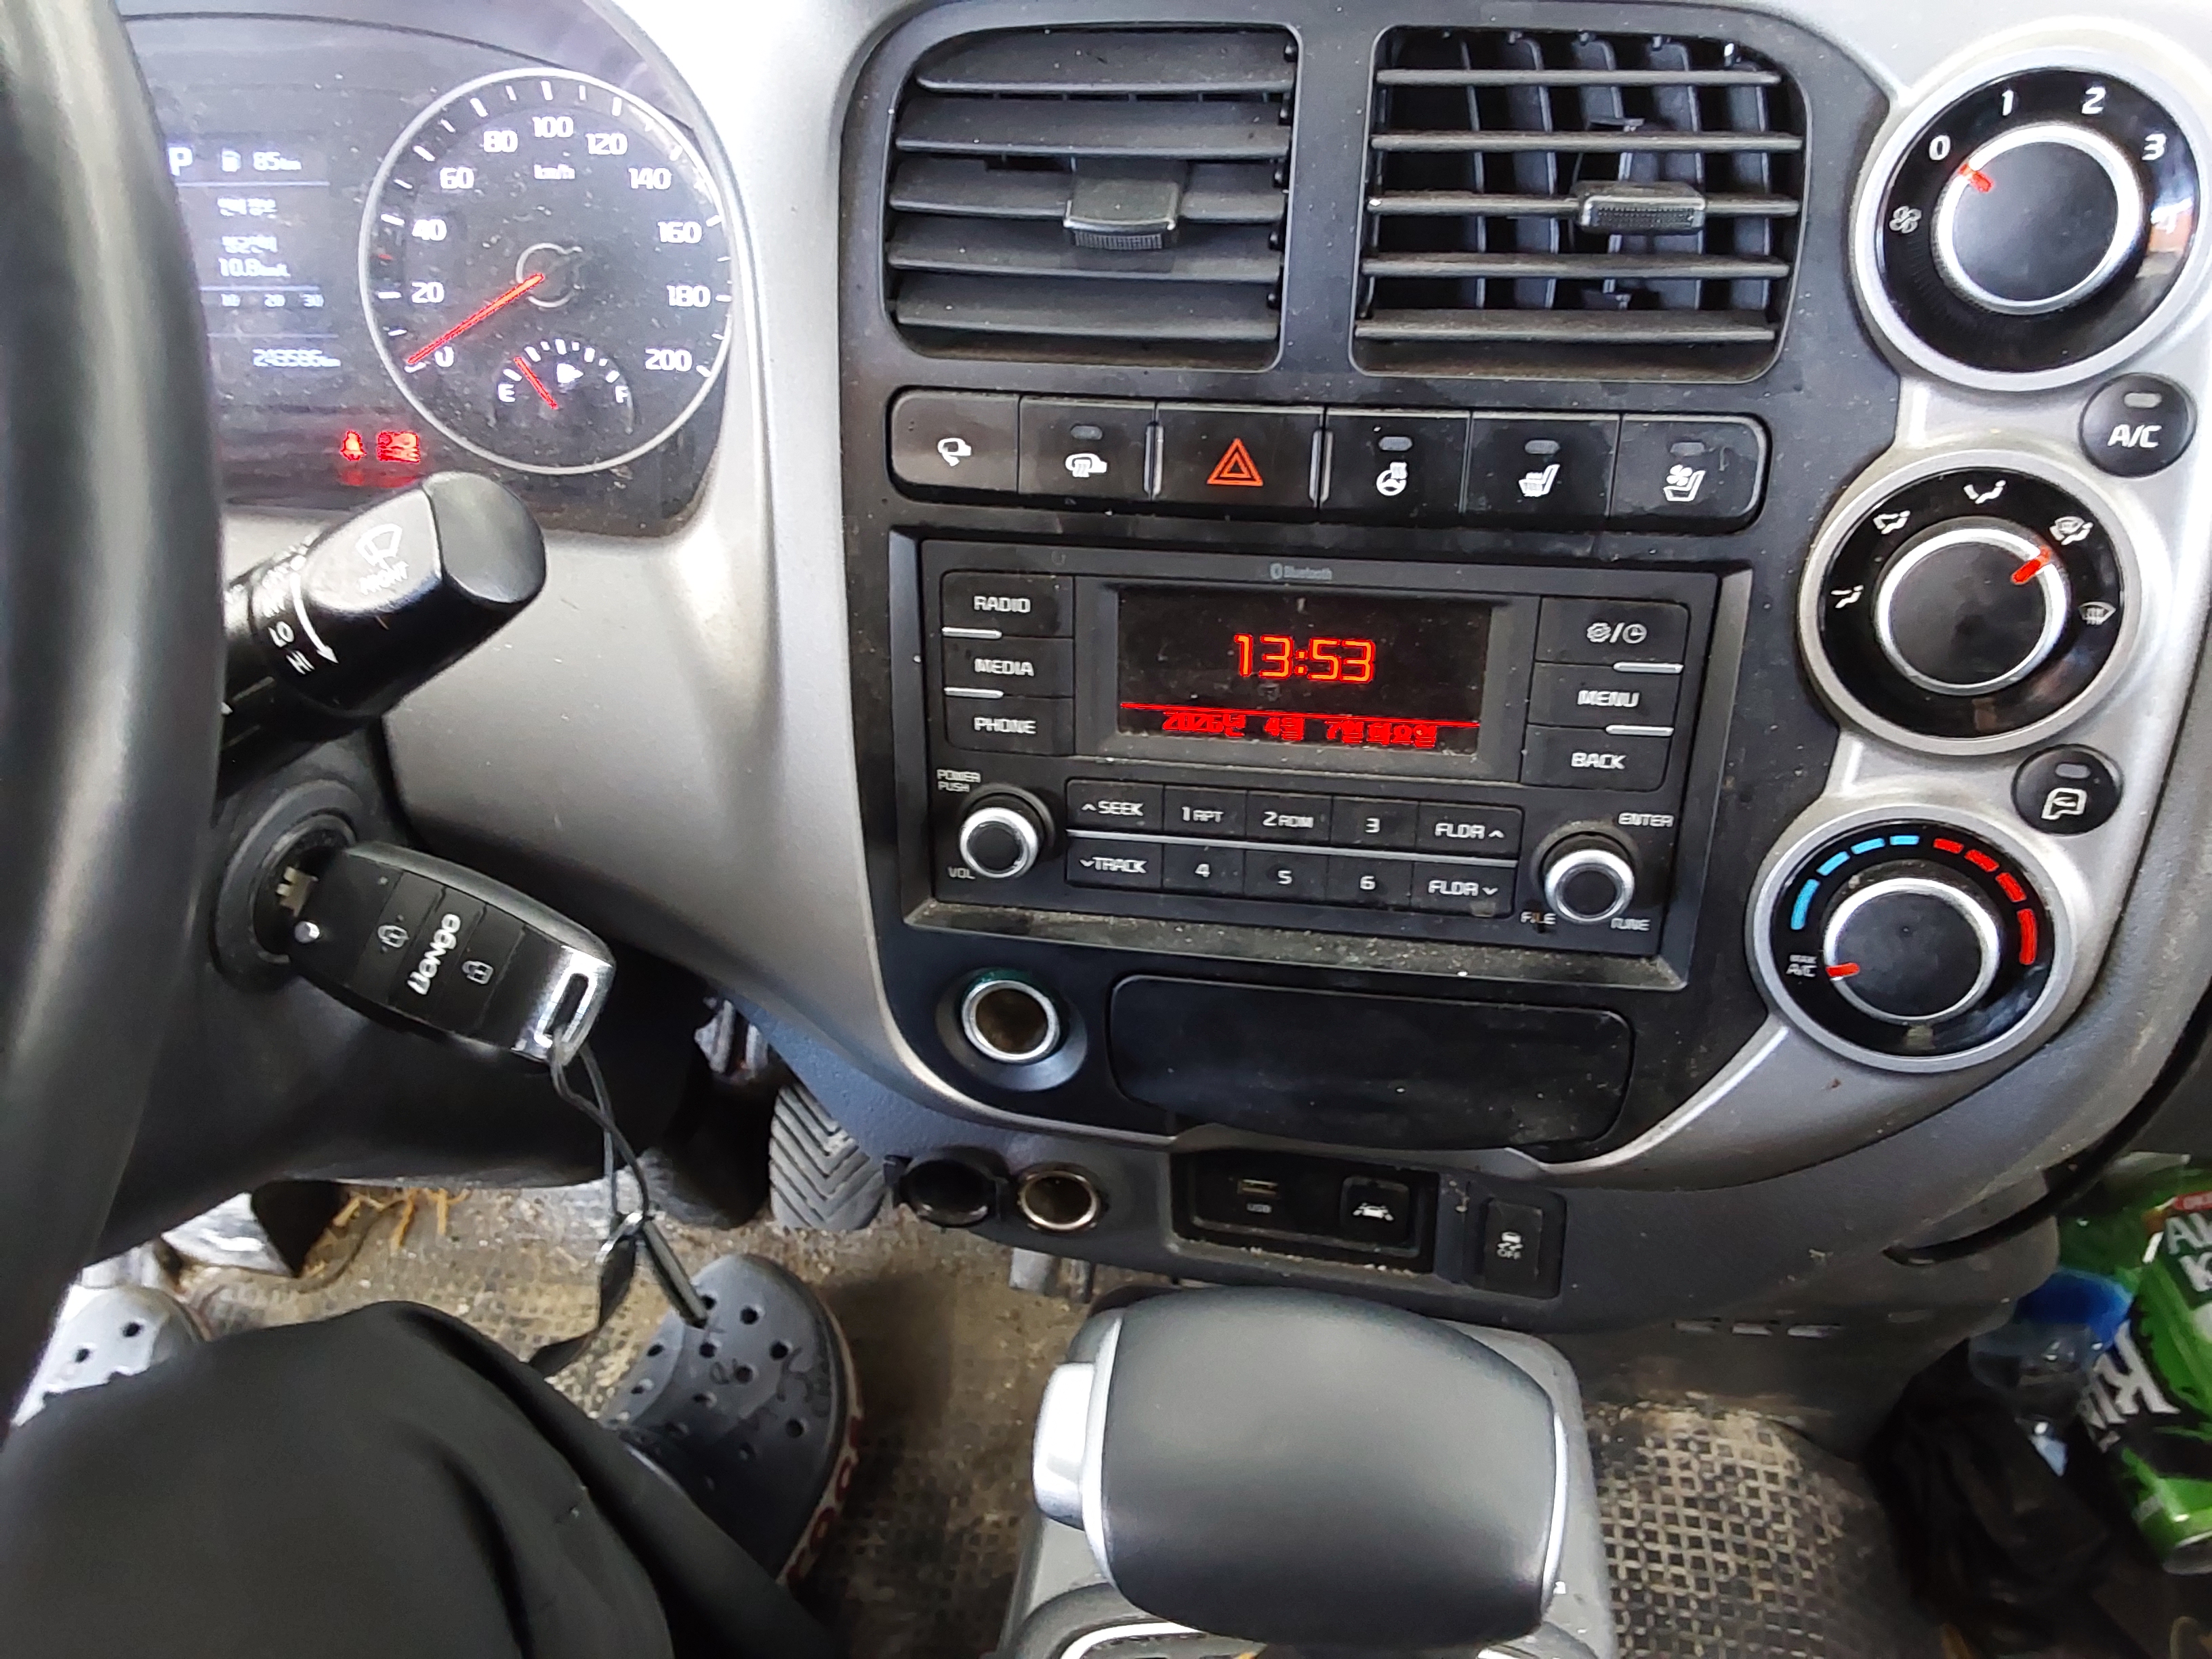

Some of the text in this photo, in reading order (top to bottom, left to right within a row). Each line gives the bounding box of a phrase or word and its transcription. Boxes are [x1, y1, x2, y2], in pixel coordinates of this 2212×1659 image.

[2001, 89, 2014, 116] 1
[2081, 85, 2107, 115] 2
[531, 115, 574, 138] 100
[483, 130, 518, 152] 80
[584, 131, 628, 155] 120
[1929, 134, 1951, 161] 0
[2142, 133, 2167, 161] 3
[168, 146, 193, 176] P
[439, 168, 474, 189] 60
[628, 167, 673, 190] 140
[411, 219, 447, 241] 40
[657, 220, 703, 244] 160
[411, 281, 445, 304] 20
[666, 285, 711, 307] 180
[644, 348, 693, 372] 200
[497, 382, 516, 403] E
[615, 385, 629, 403] F
[2108, 425, 2162, 448] A/C
[974, 596, 1031, 613] RADIO
[268, 621, 294, 647] LO
[974, 658, 1034, 676] MEDIA
[1233, 633, 1376, 684] 13:53
[1577, 690, 1639, 708] MENU
[974, 717, 1036, 735] PHONE
[1571, 752, 1626, 769] BACK
[1098, 800, 1143, 817] SEEK
[1365, 817, 1380, 833] 3
[1618, 812, 1674, 827] ENTER
[1435, 823, 1486, 840] FLDR
[948, 866, 976, 880] VOL
[1092, 857, 1147, 874] TRACK
[1195, 863, 1210, 878] 4
[1277, 870, 1292, 884] 5
[1359, 876, 1376, 890] 6
[1428, 880, 1479, 897] FLDR
